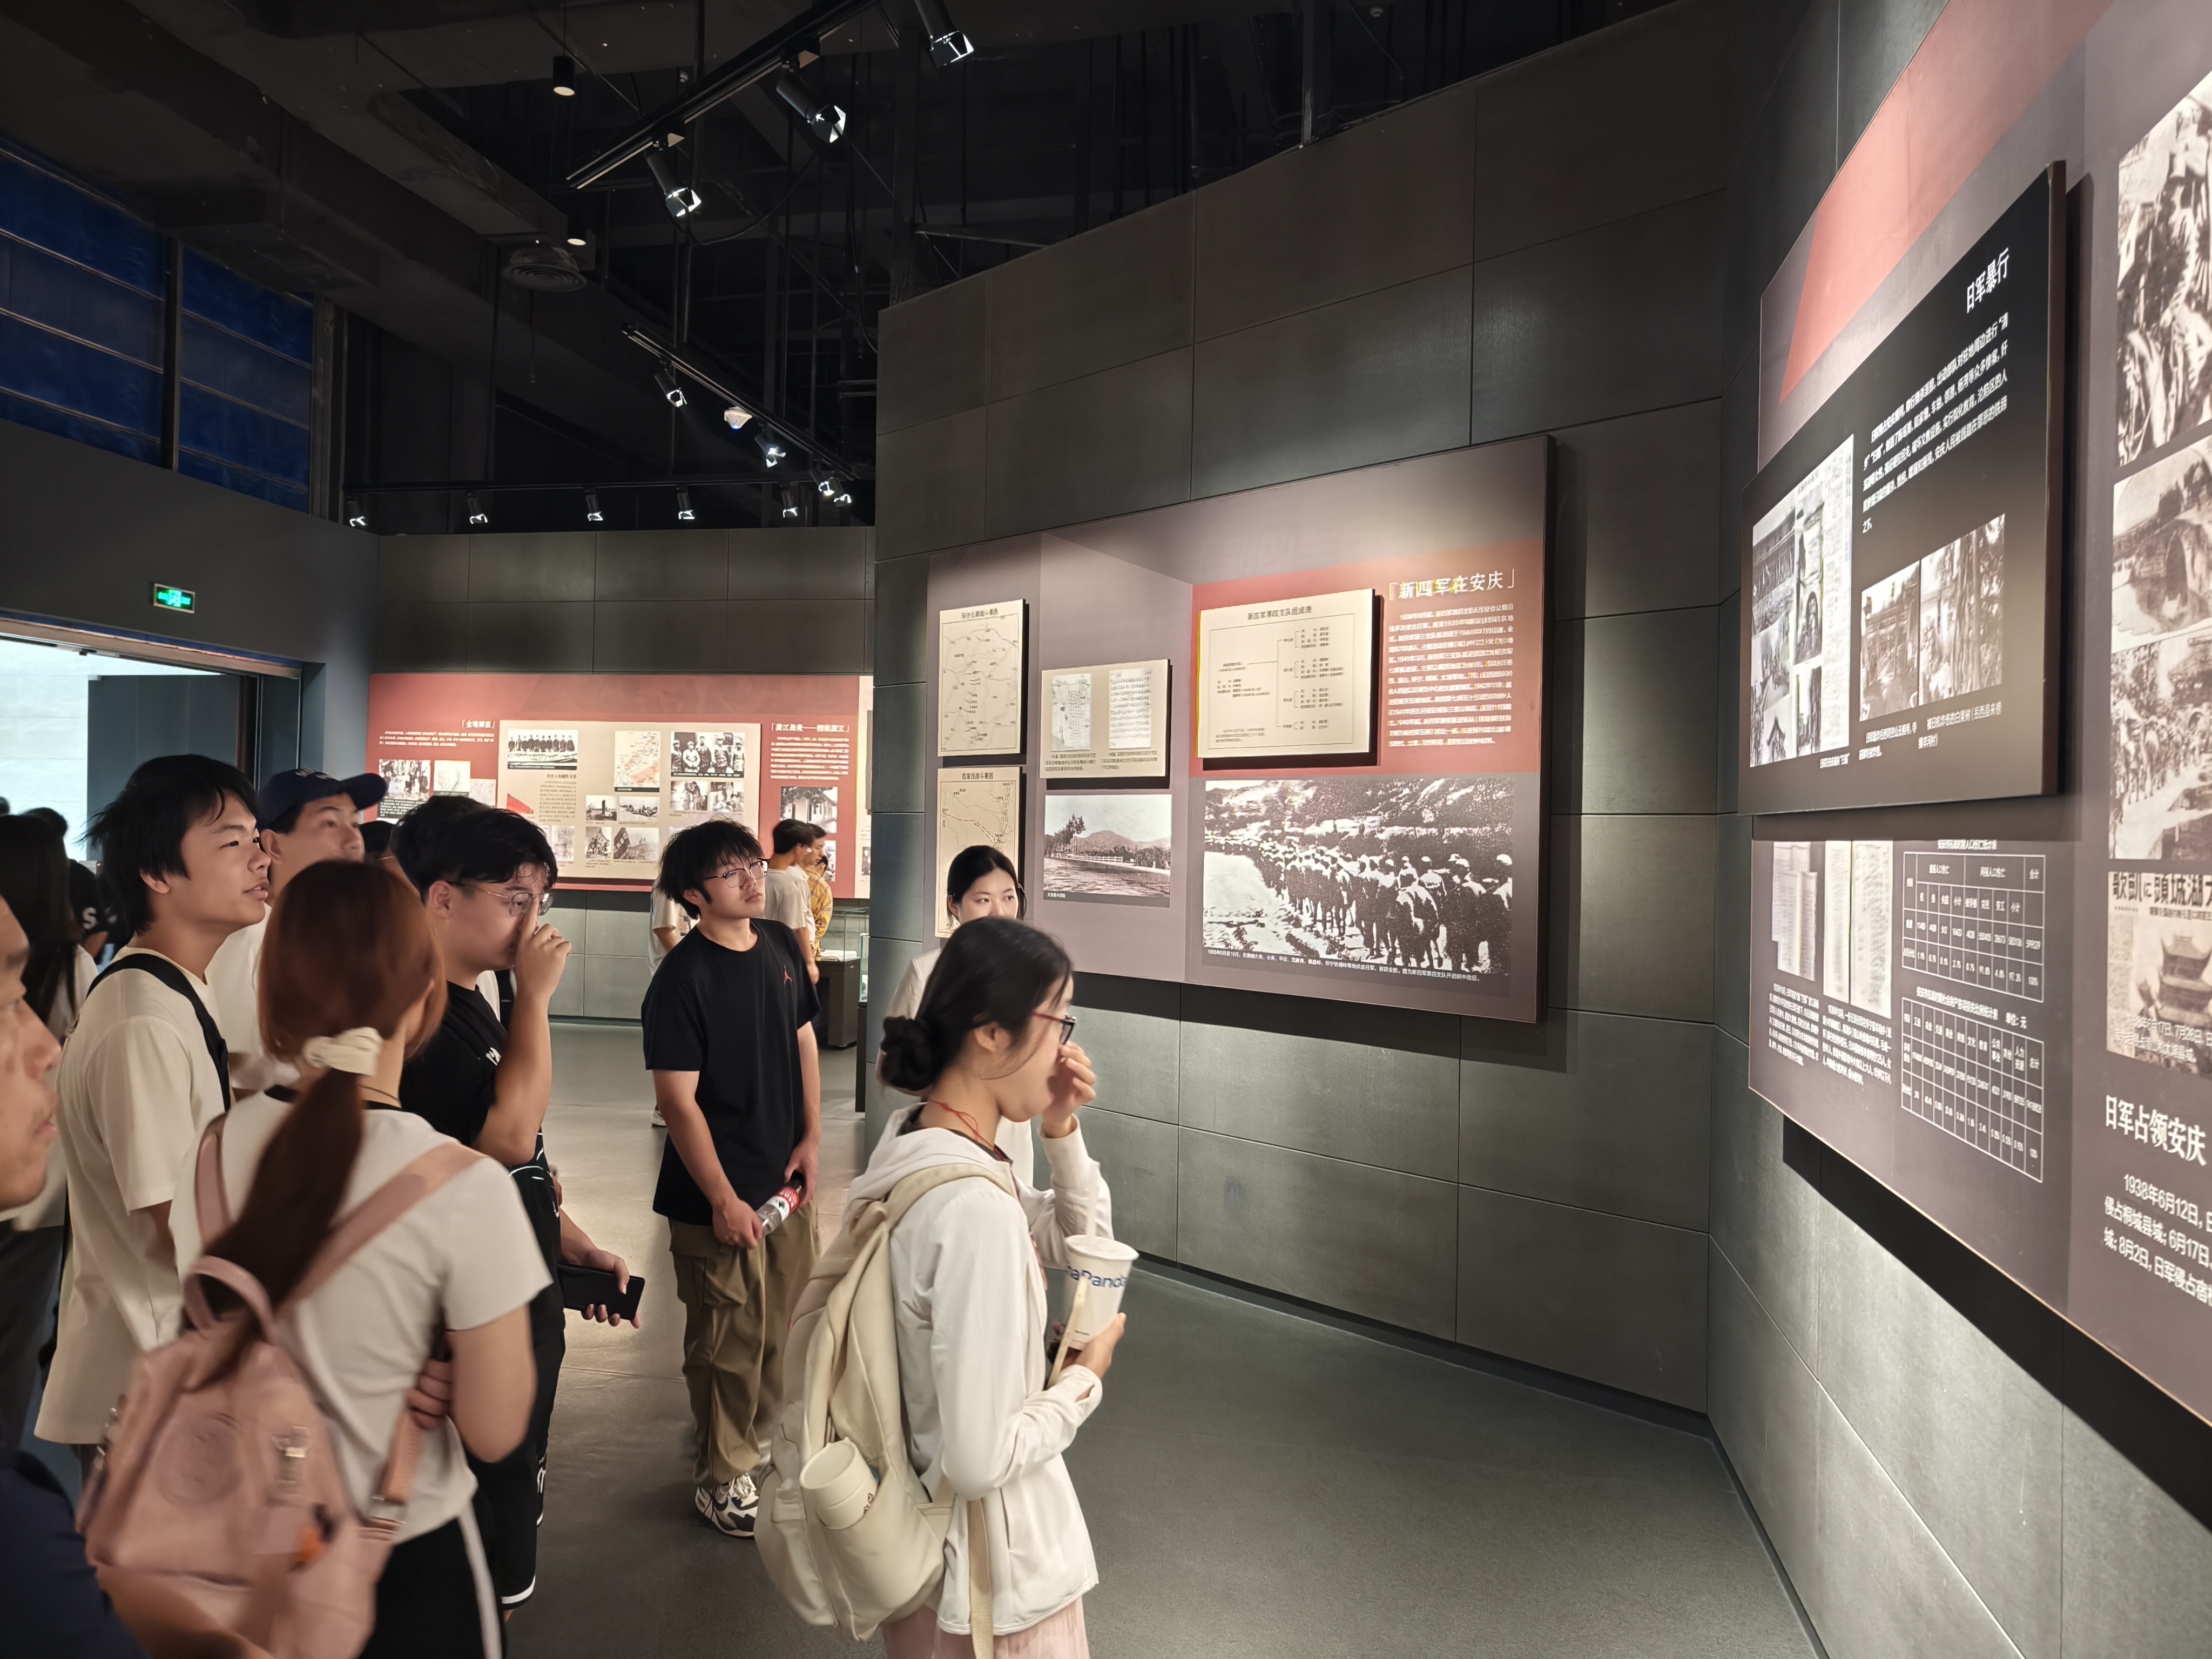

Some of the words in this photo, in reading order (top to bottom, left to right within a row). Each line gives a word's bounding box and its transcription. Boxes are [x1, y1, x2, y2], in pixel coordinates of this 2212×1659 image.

[1967, 247, 2009, 313] 日军暴行
[2106, 1095, 2207, 1166] 日军占领安庆
